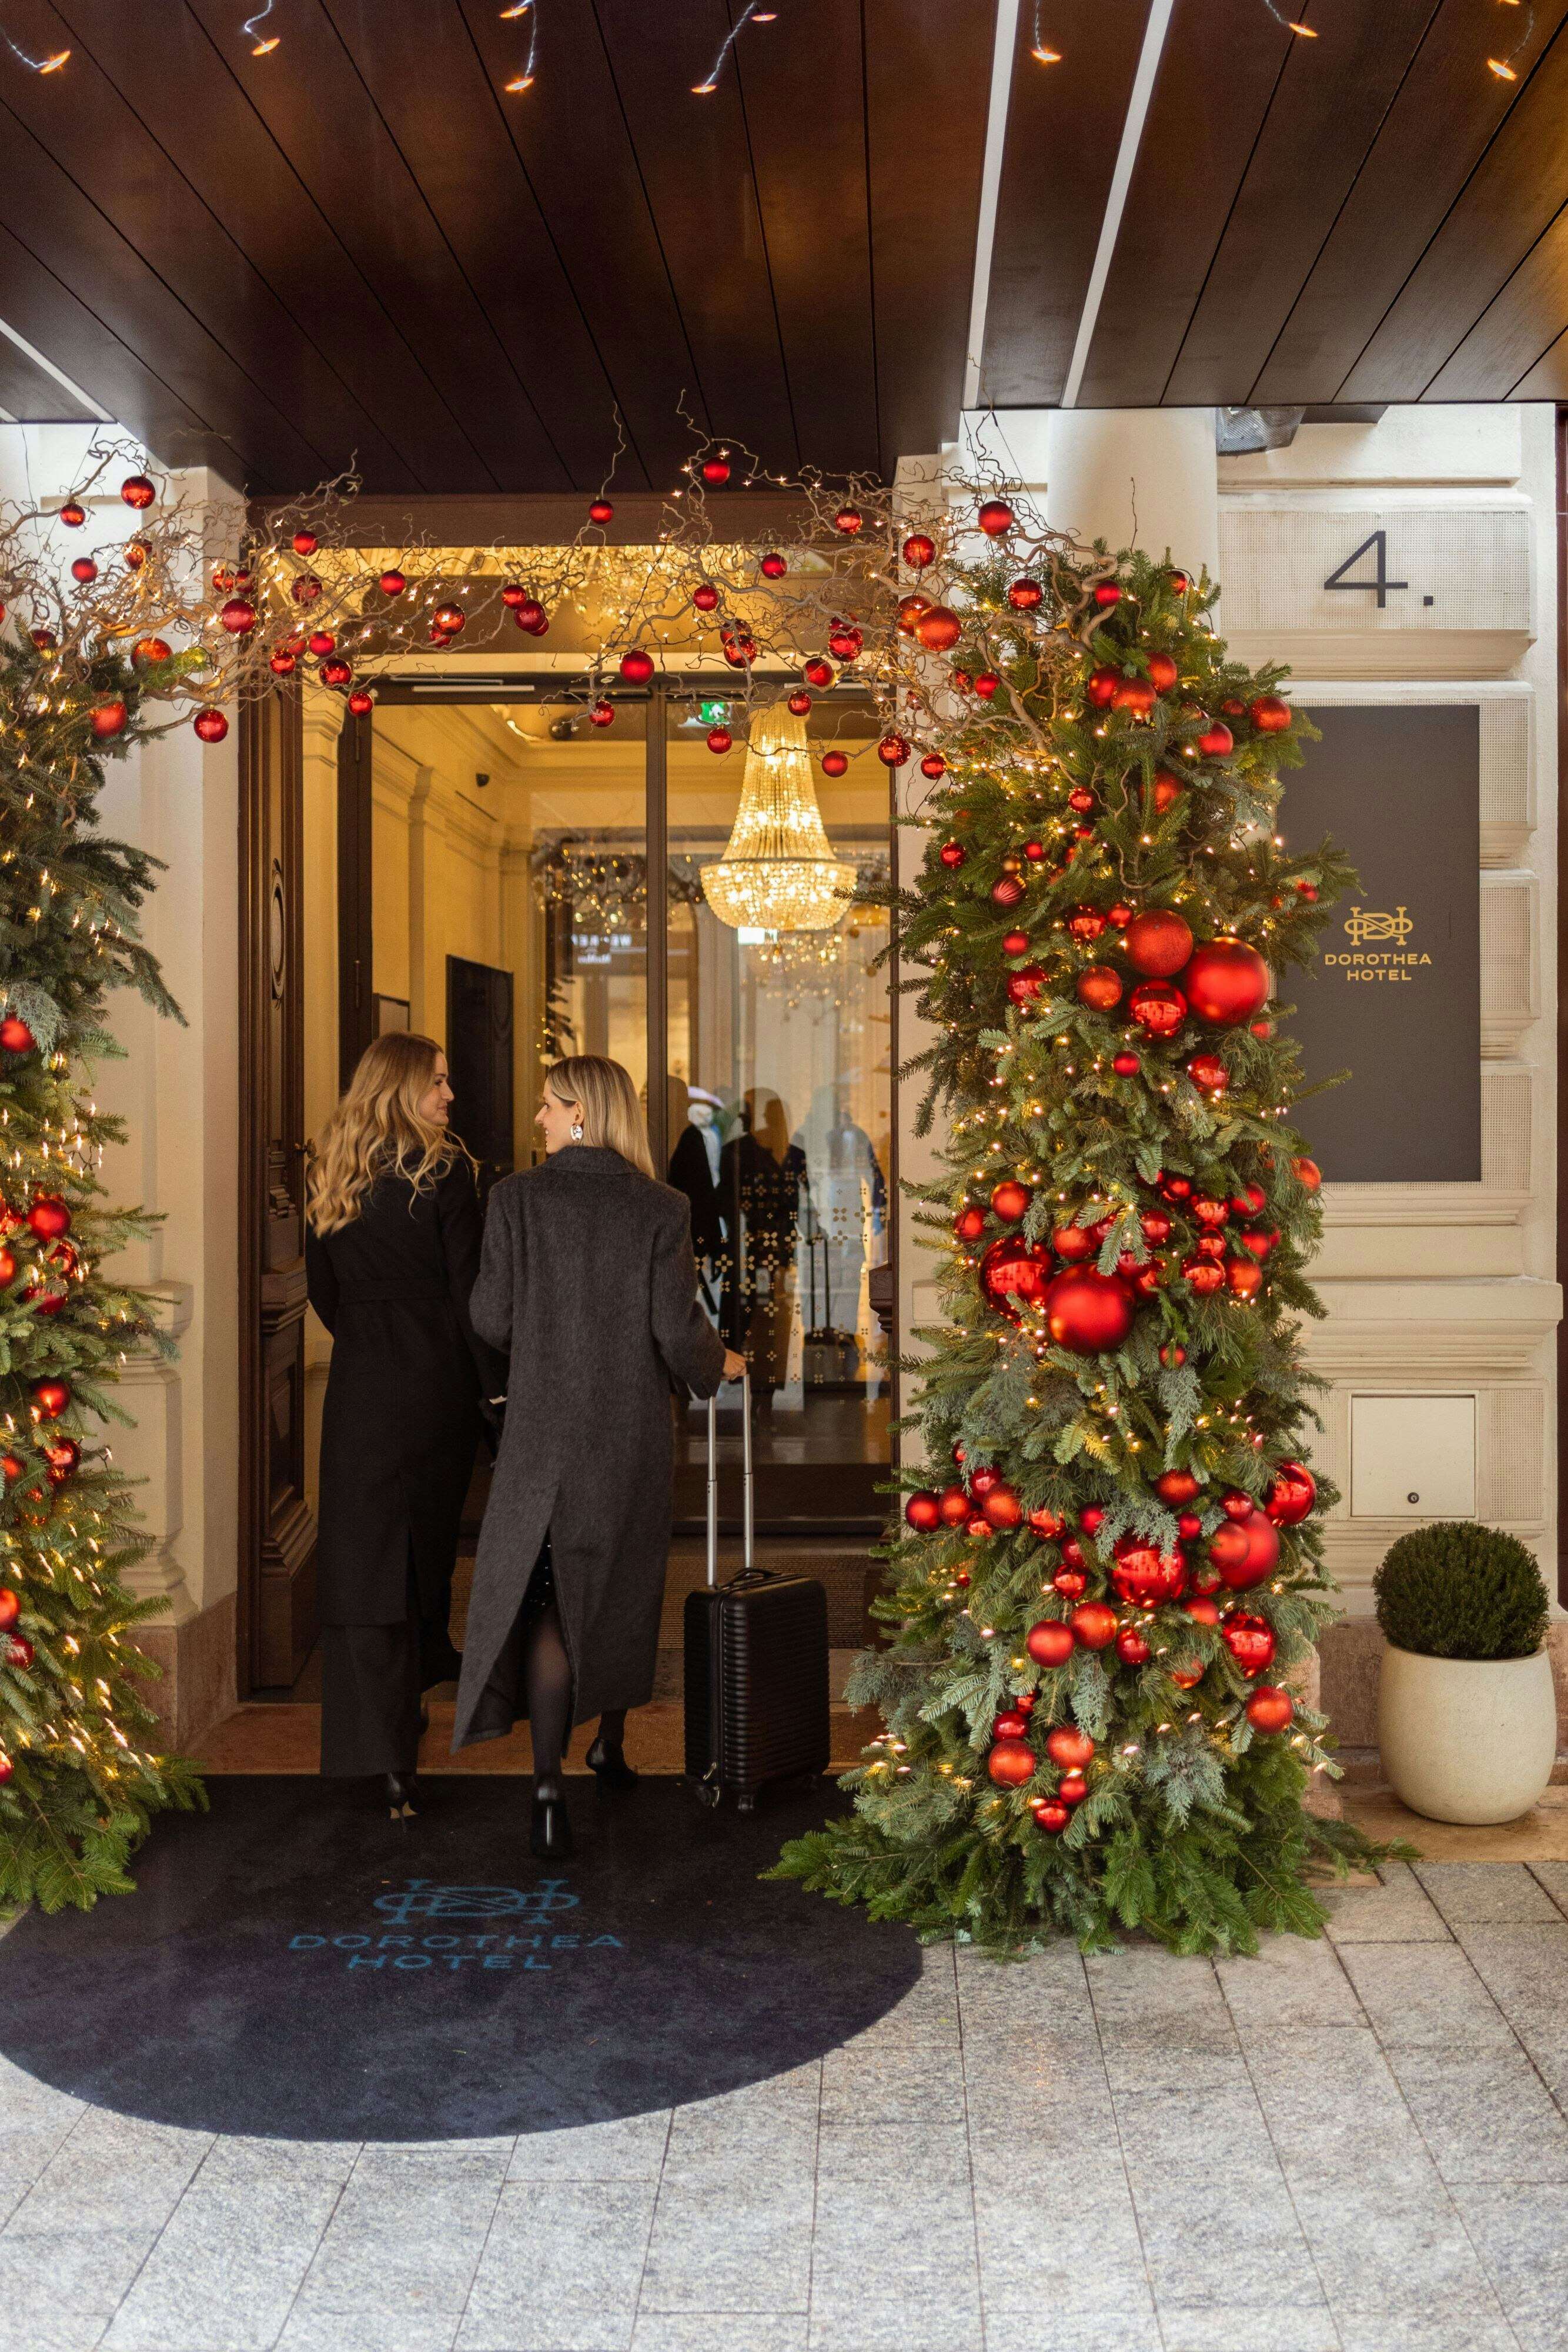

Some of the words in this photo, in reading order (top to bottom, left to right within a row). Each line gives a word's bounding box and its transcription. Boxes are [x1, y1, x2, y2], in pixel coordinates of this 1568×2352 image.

[1324, 530, 1433, 608] 4.
[1325, 953, 1432, 965] DOROTHEA
[1346, 969, 1412, 981] HOTEL
[288, 1934, 624, 1949] DOROTHEA
[347, 1954, 553, 1970] HOTEL
